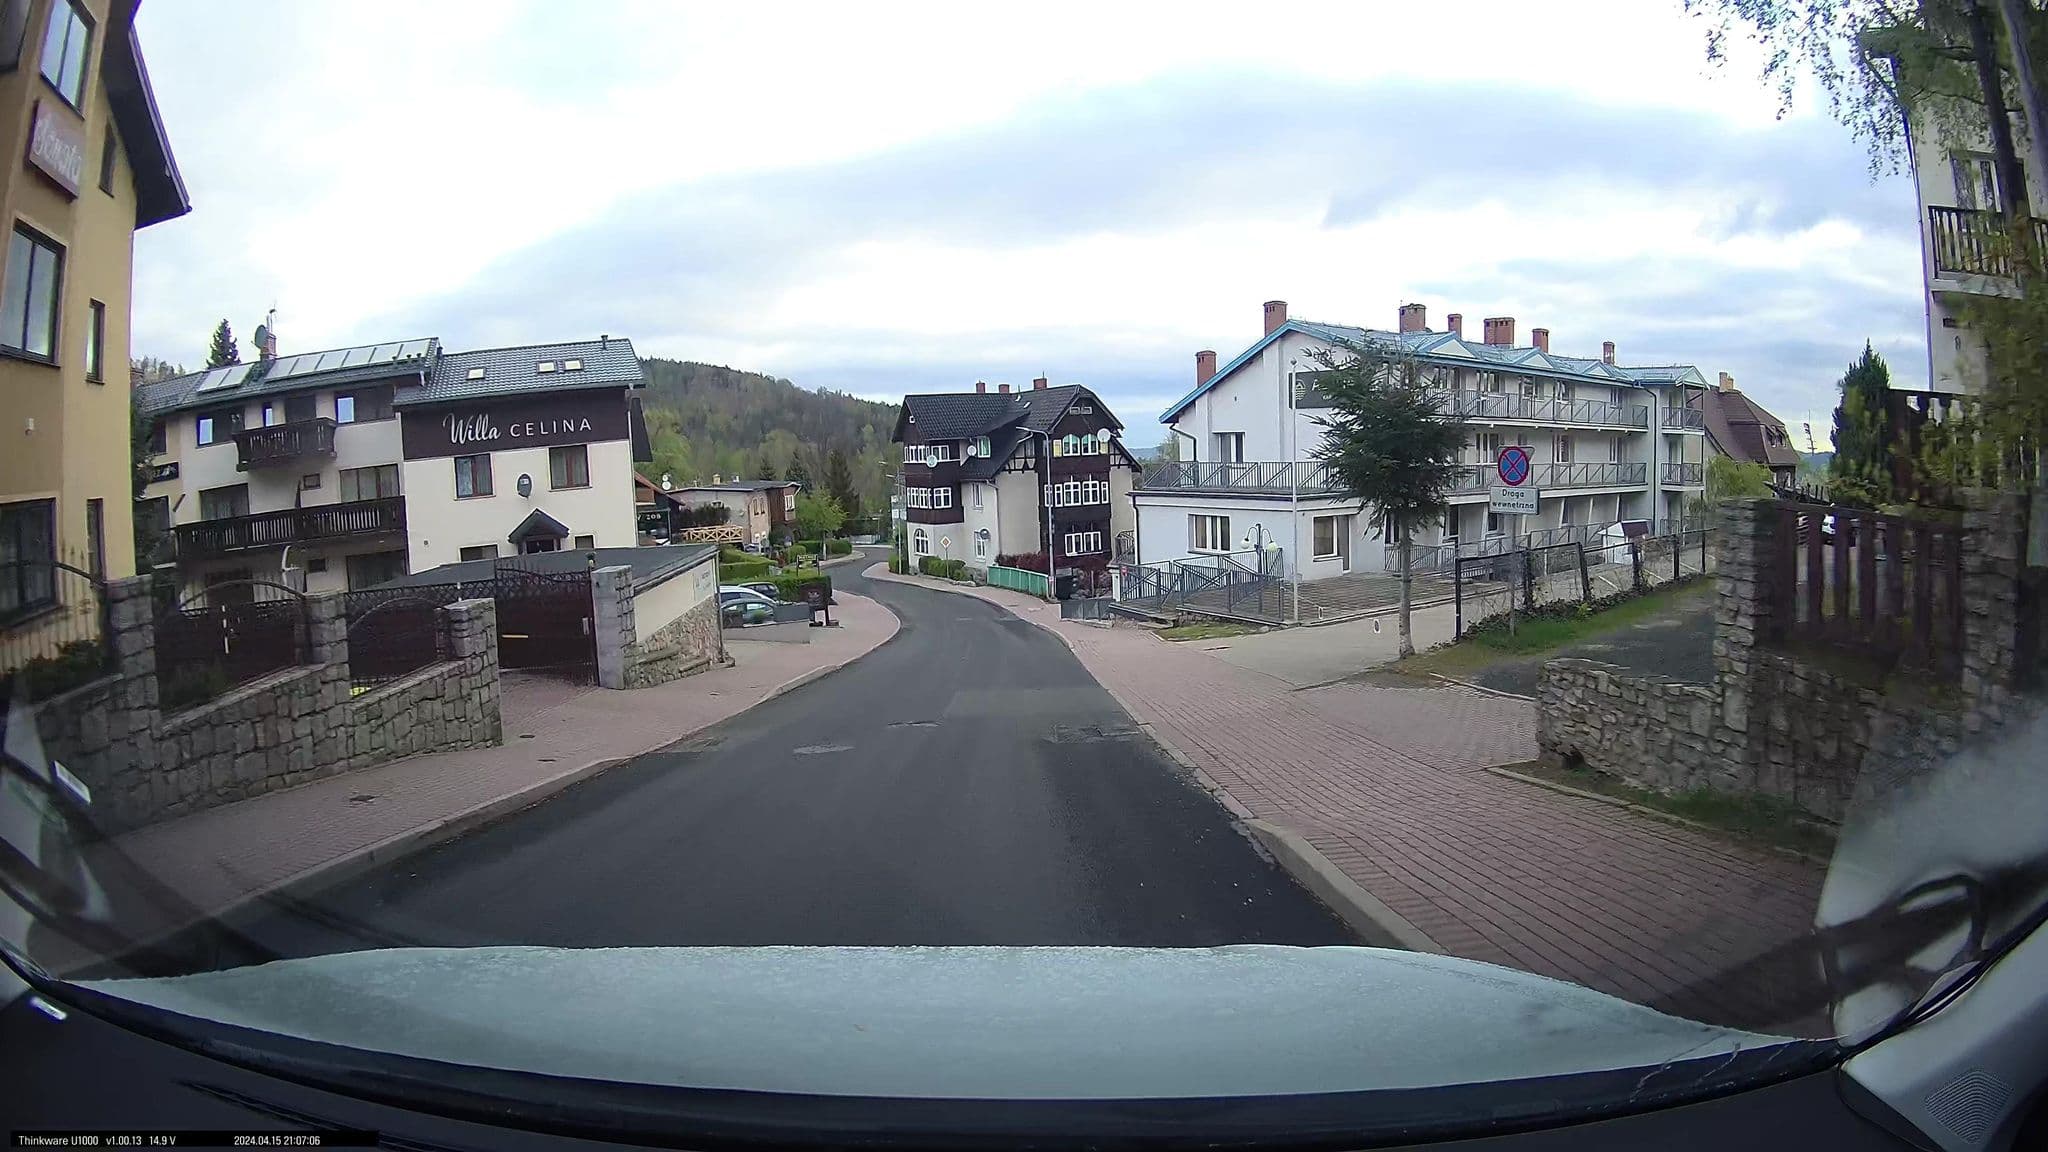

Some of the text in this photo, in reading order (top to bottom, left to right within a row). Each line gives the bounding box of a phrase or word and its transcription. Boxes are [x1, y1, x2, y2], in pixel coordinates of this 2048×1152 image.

[442, 413, 593, 444] Willa CELINA
[1502, 488, 1525, 499] Droga
